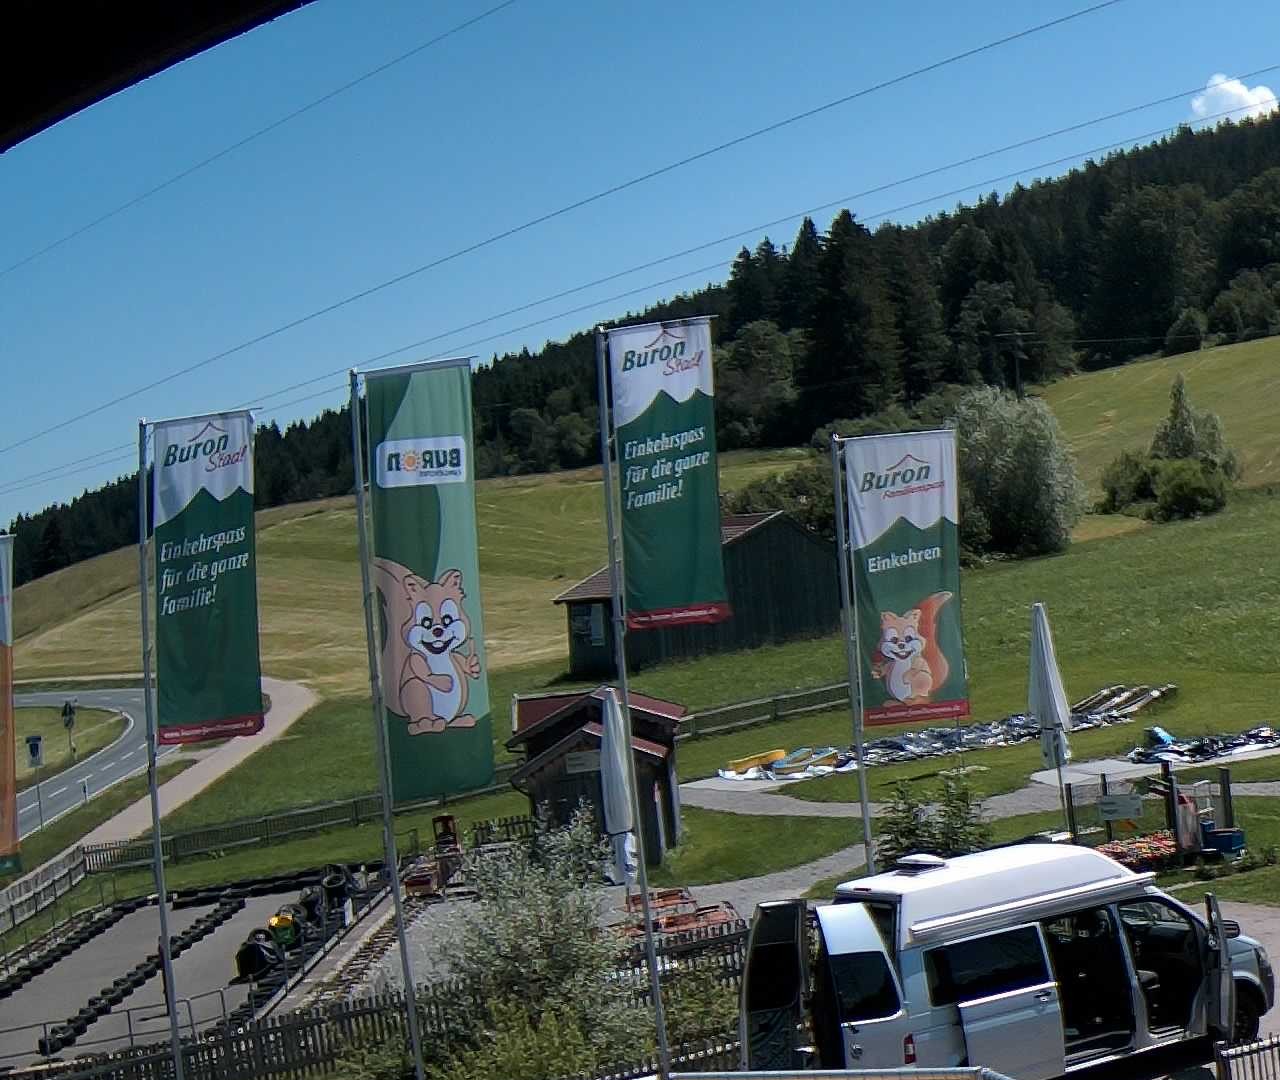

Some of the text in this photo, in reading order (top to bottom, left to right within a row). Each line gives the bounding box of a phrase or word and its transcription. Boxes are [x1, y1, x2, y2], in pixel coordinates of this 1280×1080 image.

[622, 341, 686, 372] Buron
[164, 434, 229, 467] Buron
[624, 465, 649, 490] für
[651, 458, 673, 479] die
[859, 465, 930, 493] Buron
[626, 479, 684, 510] Familie!
[187, 561, 209, 582] die
[867, 546, 941, 573] Einkehren
